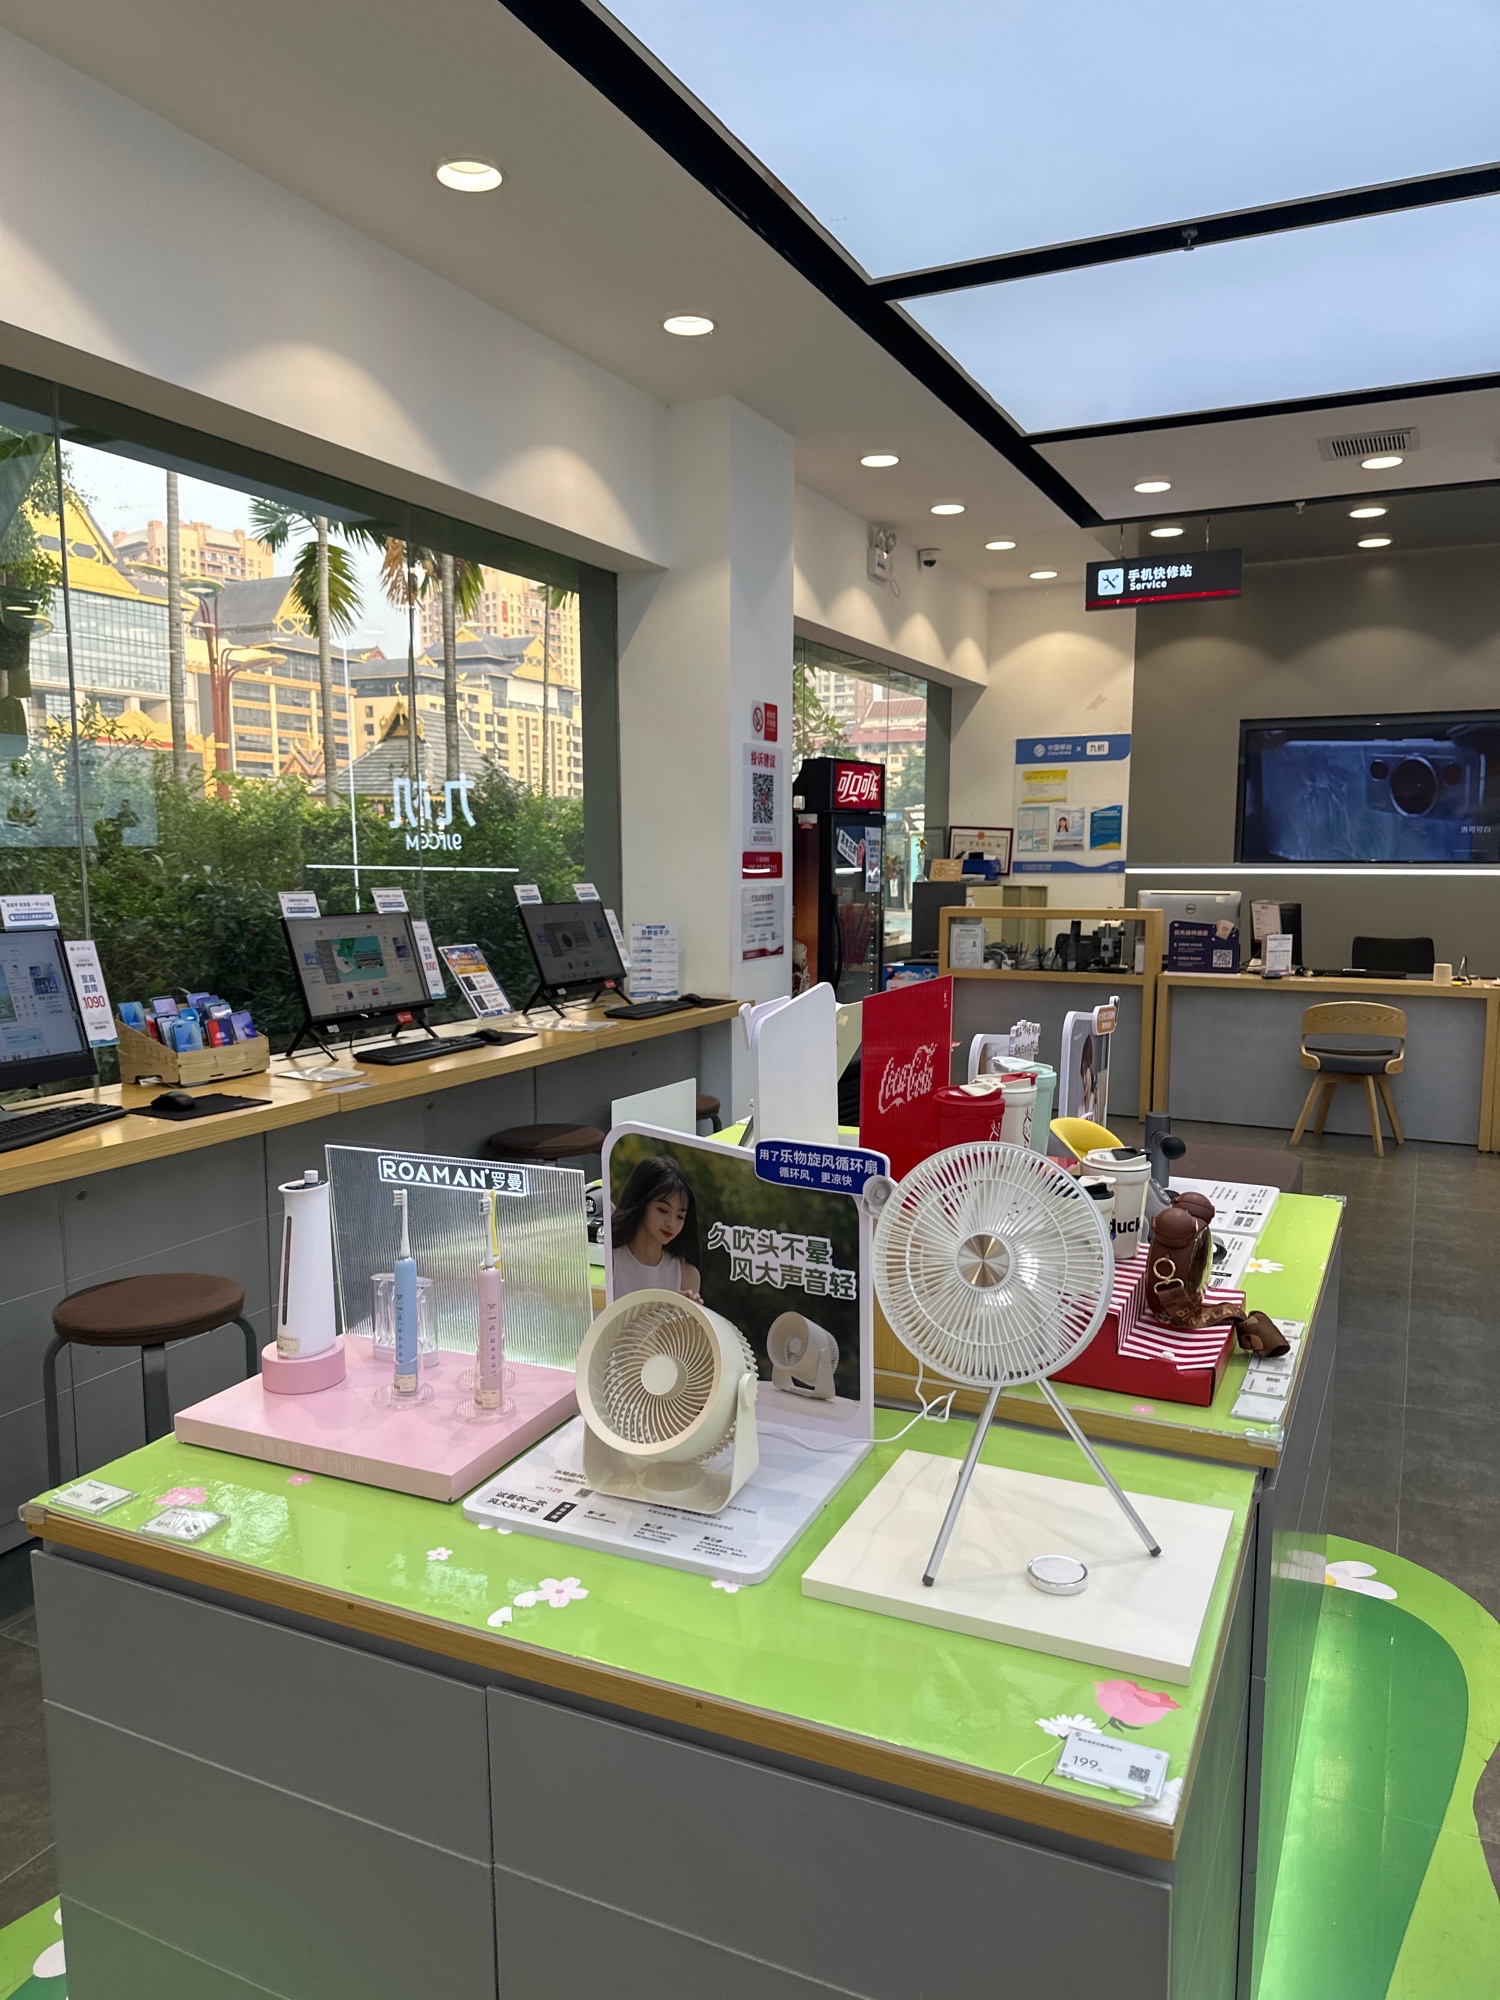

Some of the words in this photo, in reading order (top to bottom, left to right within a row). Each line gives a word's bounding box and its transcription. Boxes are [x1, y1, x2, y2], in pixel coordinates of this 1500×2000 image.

[1127, 564, 1193, 582] 手机快修站
[1129, 579, 1168, 591] Service
[837, 769, 882, 803] 可口可乐
[83, 995, 106, 1010] 1090
[382, 1159, 487, 1189] ROAMAN
[491, 1170, 524, 1192] 罗曼
[759, 1148, 879, 1176] 用了乐物旋风循环扇
[708, 1223, 831, 1267] 久吹头不晕
[731, 1256, 856, 1300] 风大声音轻
